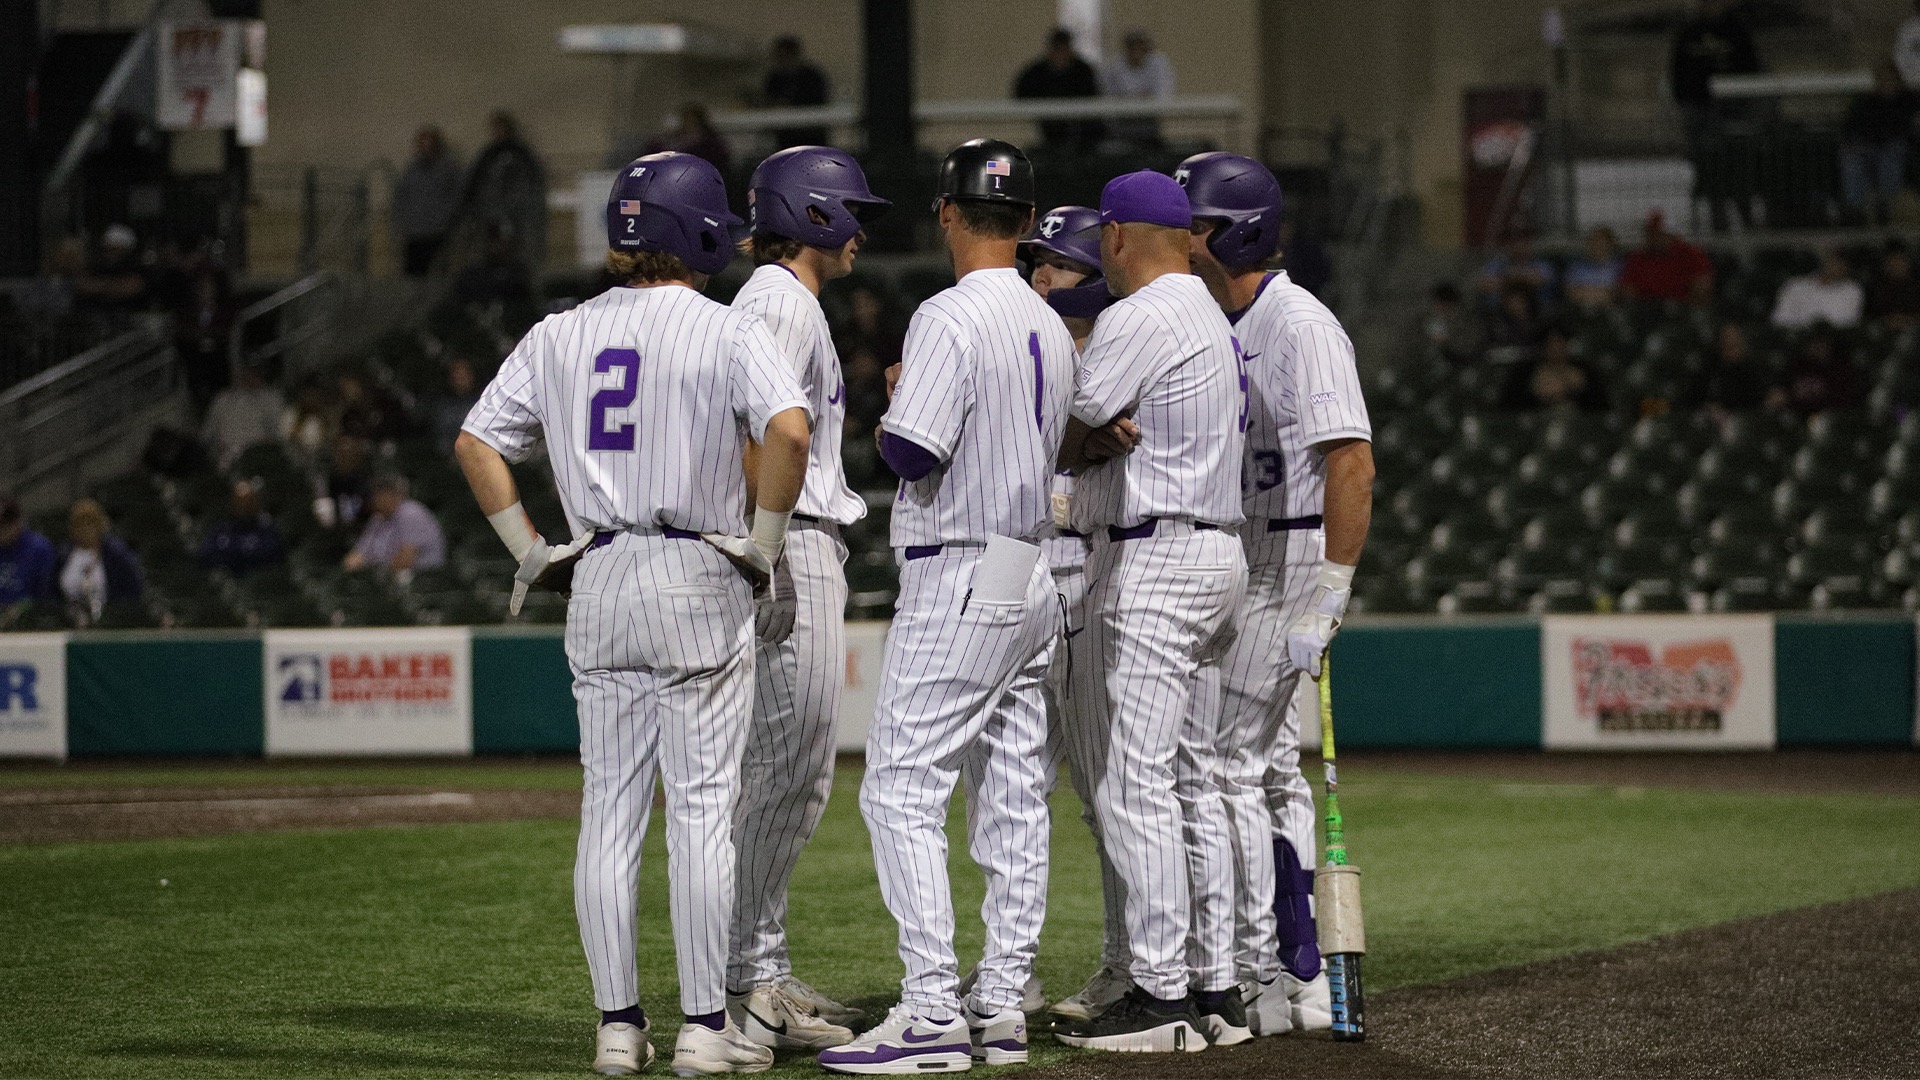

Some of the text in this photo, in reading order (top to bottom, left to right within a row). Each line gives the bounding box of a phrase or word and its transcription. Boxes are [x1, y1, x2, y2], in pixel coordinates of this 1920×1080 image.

[995, 176, 1000, 189] 1
[627, 218, 634, 233] 2
[587, 347, 641, 452] 2
[1029, 330, 1043, 436] 1
[1310, 391, 1336, 404] WAC
[1241, 451, 1284, 491] 3
[329, 653, 452, 679] BAKER
[1330, 953, 1357, 1032] rucci
